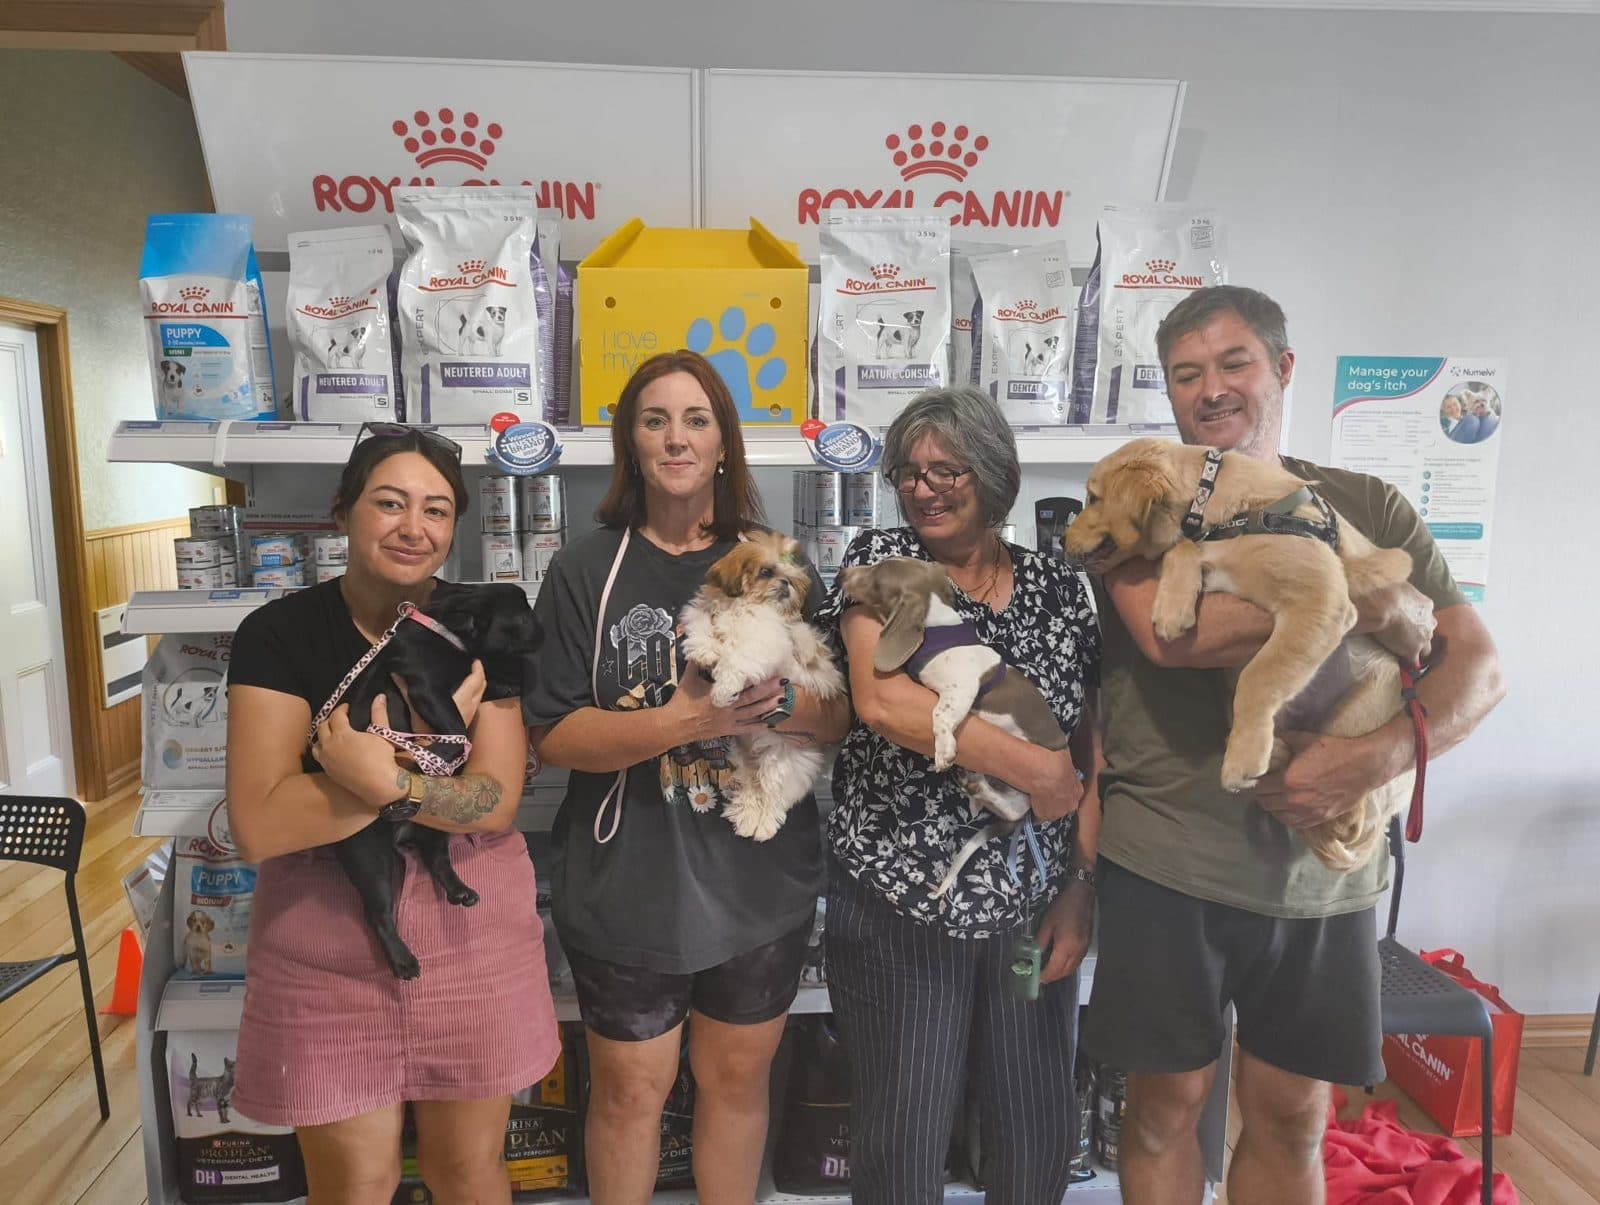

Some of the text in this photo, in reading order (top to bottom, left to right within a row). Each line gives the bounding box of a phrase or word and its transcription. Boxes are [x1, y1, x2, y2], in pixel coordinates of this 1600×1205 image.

[933, 190, 1064, 228] CANIN
[430, 266, 508, 288] ROYAL CANIN
[846, 278, 926, 291] ROYAL CANIN
[1122, 274, 1203, 286] ROYAL CANIN
[152, 302, 234, 314] ROYAL CANIN
[304, 298, 369, 317] ROYAL CANIN
[997, 306, 1059, 321] ROYAL CANIN
[955, 318, 972, 328] ROY
[166, 328, 202, 339] PUPPY
[611, 330, 657, 350] love
[603, 352, 637, 376] my
[444, 366, 527, 379] NEUTERED ADULT
[861, 368, 898, 381] MATURE
[1140, 367, 1165, 380] DENT
[1348, 366, 1429, 381] Manage your
[1462, 367, 1496, 378] Numelvi
[319, 376, 386, 388] NEUTERED ADULT
[1347, 379, 1408, 393] dog's itch
[377, 397, 387, 407] S
[516, 391, 529, 402] S
[510, 439, 545, 454] BRAND
[830, 436, 860, 456] BRAND
[181, 644, 218, 660] ROYAL
[198, 871, 241, 887] PUPPY
[1411, 1041, 1451, 1081] CANIN
[509, 1127, 567, 1149] PLAN
[201, 1147, 268, 1158] PRO PLAN
[825, 1156, 851, 1178] DH
[195, 1169, 216, 1185] DH
